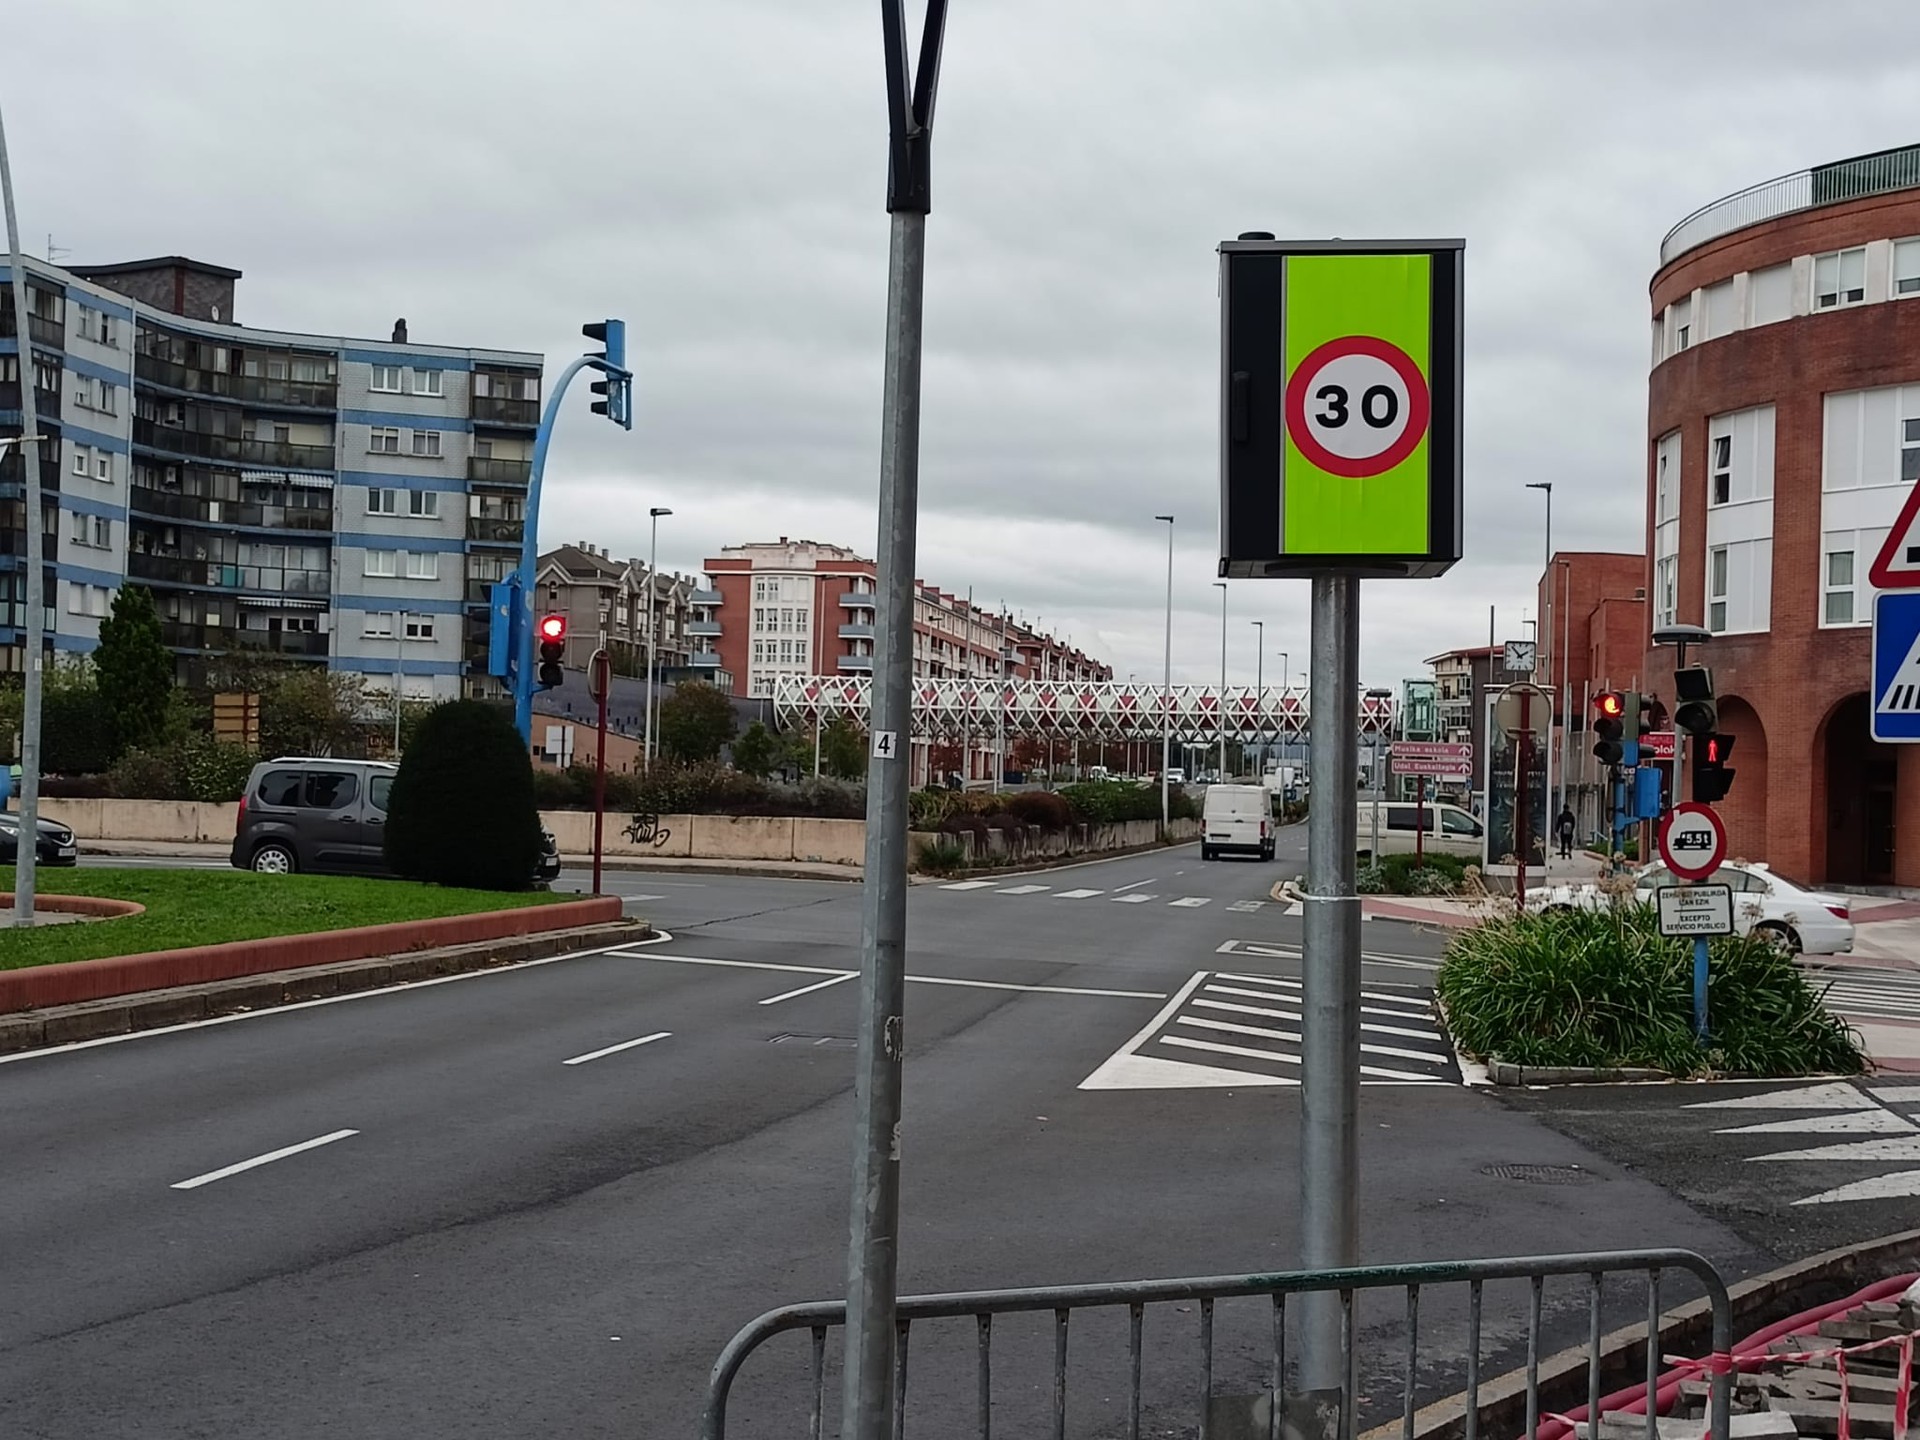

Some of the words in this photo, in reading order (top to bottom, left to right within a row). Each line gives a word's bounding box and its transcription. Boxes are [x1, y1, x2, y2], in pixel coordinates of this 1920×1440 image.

[1315, 385, 1398, 428] 30
[878, 734, 891, 755] 4
[1394, 745, 1421, 753] Musika
[1394, 762, 1411, 770] Udal
